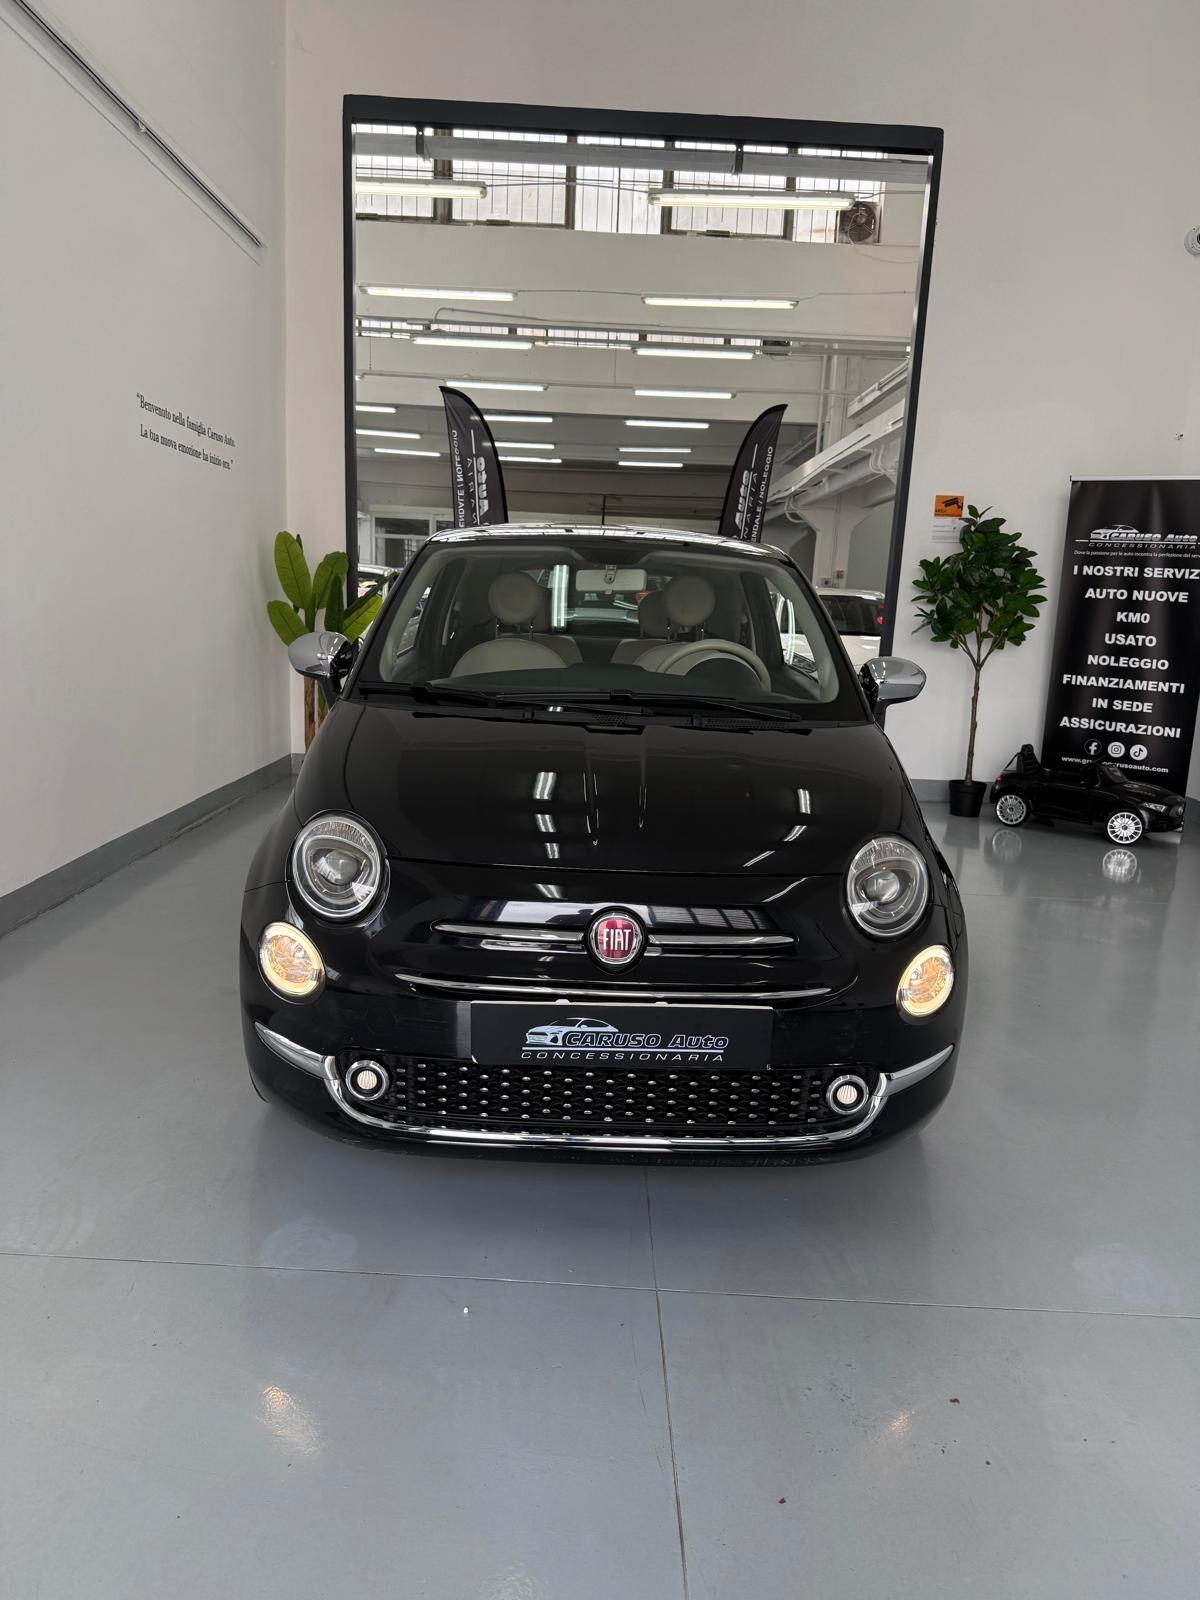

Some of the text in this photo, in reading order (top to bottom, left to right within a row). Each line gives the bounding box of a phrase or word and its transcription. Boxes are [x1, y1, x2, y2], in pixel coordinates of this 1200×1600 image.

[172, 412, 185, 427] nella
[187, 416, 206, 437] famiglia
[207, 427, 223, 443] Caruso
[140, 424, 148, 438] La
[149, 429, 159, 443] tua
[161, 436, 177, 450] nuova
[178, 444, 201, 459] emozione
[203, 448, 208, 461] ha
[210, 452, 221, 466] inizio
[751, 505, 762, 542] ENDALE
[759, 446, 774, 498] NOLEGGIO
[1110, 533, 1198, 542] CARUSO Auto
[1073, 565, 1200, 579] I NOSTRI SERVIZ
[1085, 588, 1189, 603] AUTO NUOVE
[1104, 633, 1157, 647] USATO
[1087, 654, 1169, 670] NOLEGGIO
[1062, 674, 1185, 694] FINANZIAMENTI
[1092, 698, 1153, 713] IN SEDE
[1060, 716, 1181, 738] ASSICURAZIONI
[603, 929, 631, 951] FIAT
[565, 1033, 729, 1049] CARUSO Auto
[521, 1051, 724, 1061] CONCESSIONARIA
